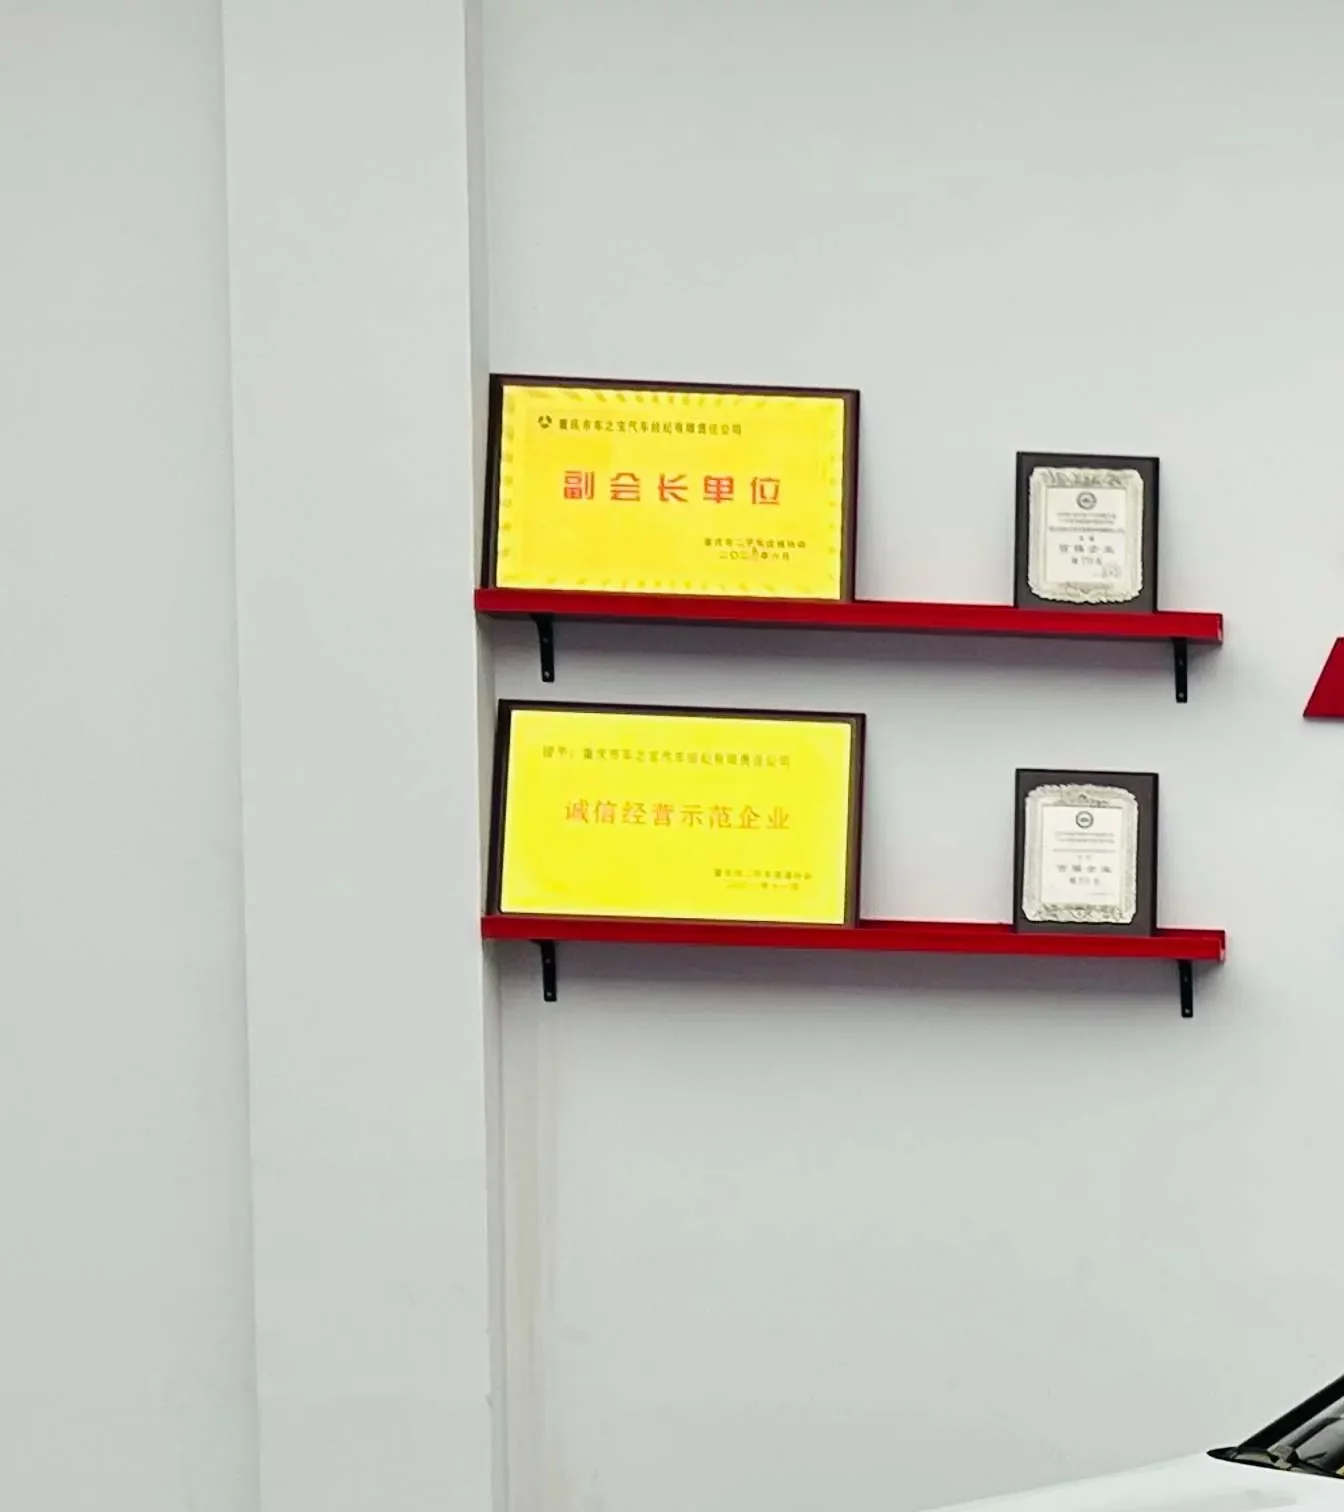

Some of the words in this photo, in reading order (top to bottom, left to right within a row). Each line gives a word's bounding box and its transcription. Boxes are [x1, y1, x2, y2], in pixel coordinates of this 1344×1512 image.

[563, 470, 781, 506] 副会长单位
[564, 798, 791, 831] 诚信经营示范企业
